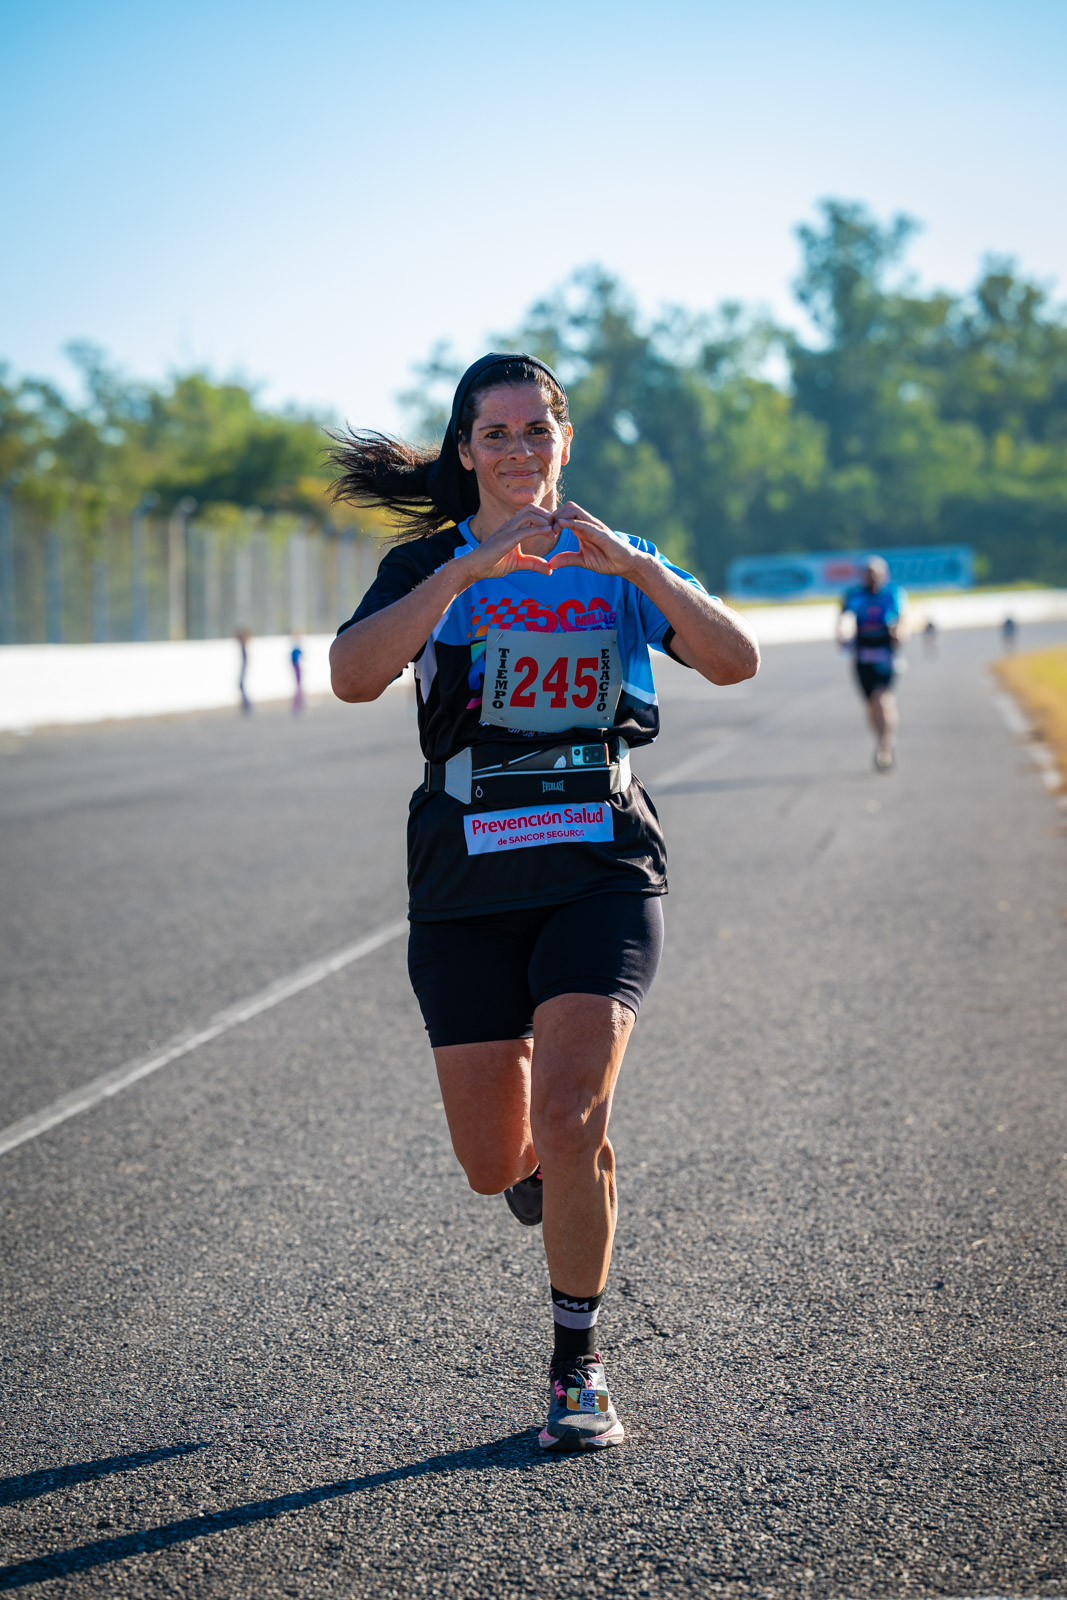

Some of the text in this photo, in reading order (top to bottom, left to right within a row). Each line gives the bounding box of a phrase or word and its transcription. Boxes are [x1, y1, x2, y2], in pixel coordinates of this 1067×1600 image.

[492, 648, 510, 709] TIEMPO
[509, 656, 599, 709] 245
[596, 649, 611, 712] EXACTO
[541, 779, 566, 793] EVERLAST
[472, 807, 604, 835] Prevención Salud
[497, 829, 585, 846] de SANCOR SEGUROS
[582, 1391, 595, 1407] 245
